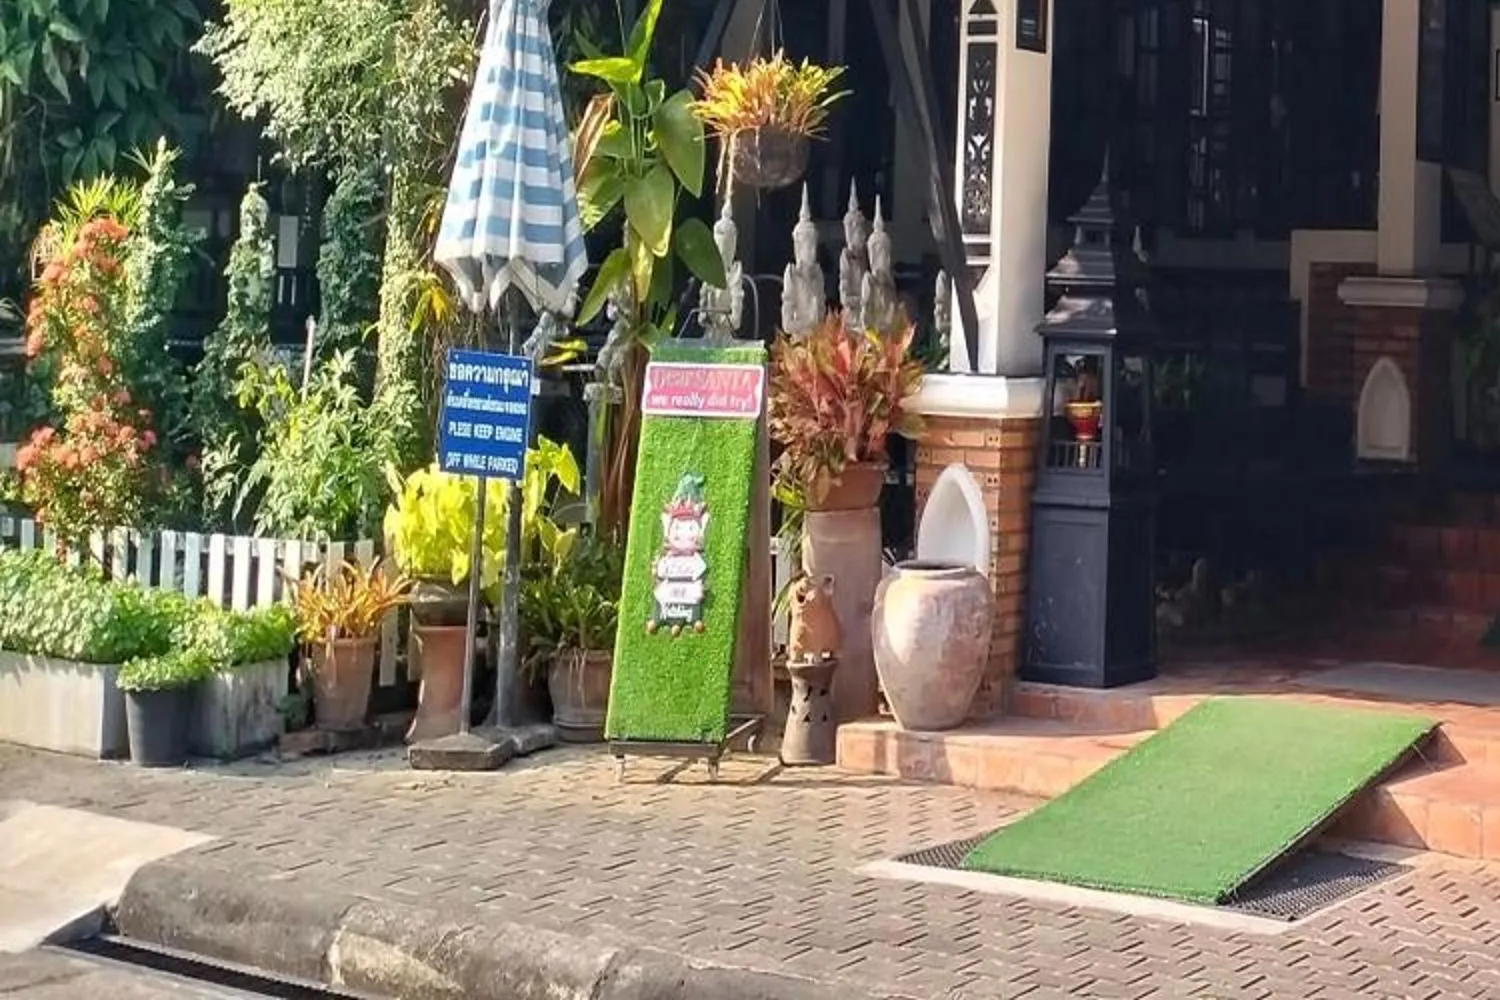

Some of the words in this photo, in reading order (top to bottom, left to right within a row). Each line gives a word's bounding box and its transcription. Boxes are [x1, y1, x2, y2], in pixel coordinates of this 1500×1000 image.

[671, 391, 704, 409] really
[474, 424, 493, 439] KEEP
[496, 426, 522, 442] ENGINE
[446, 452, 461, 468] OFF
[464, 454, 486, 470] WHILE
[488, 456, 518, 474] PARKED
